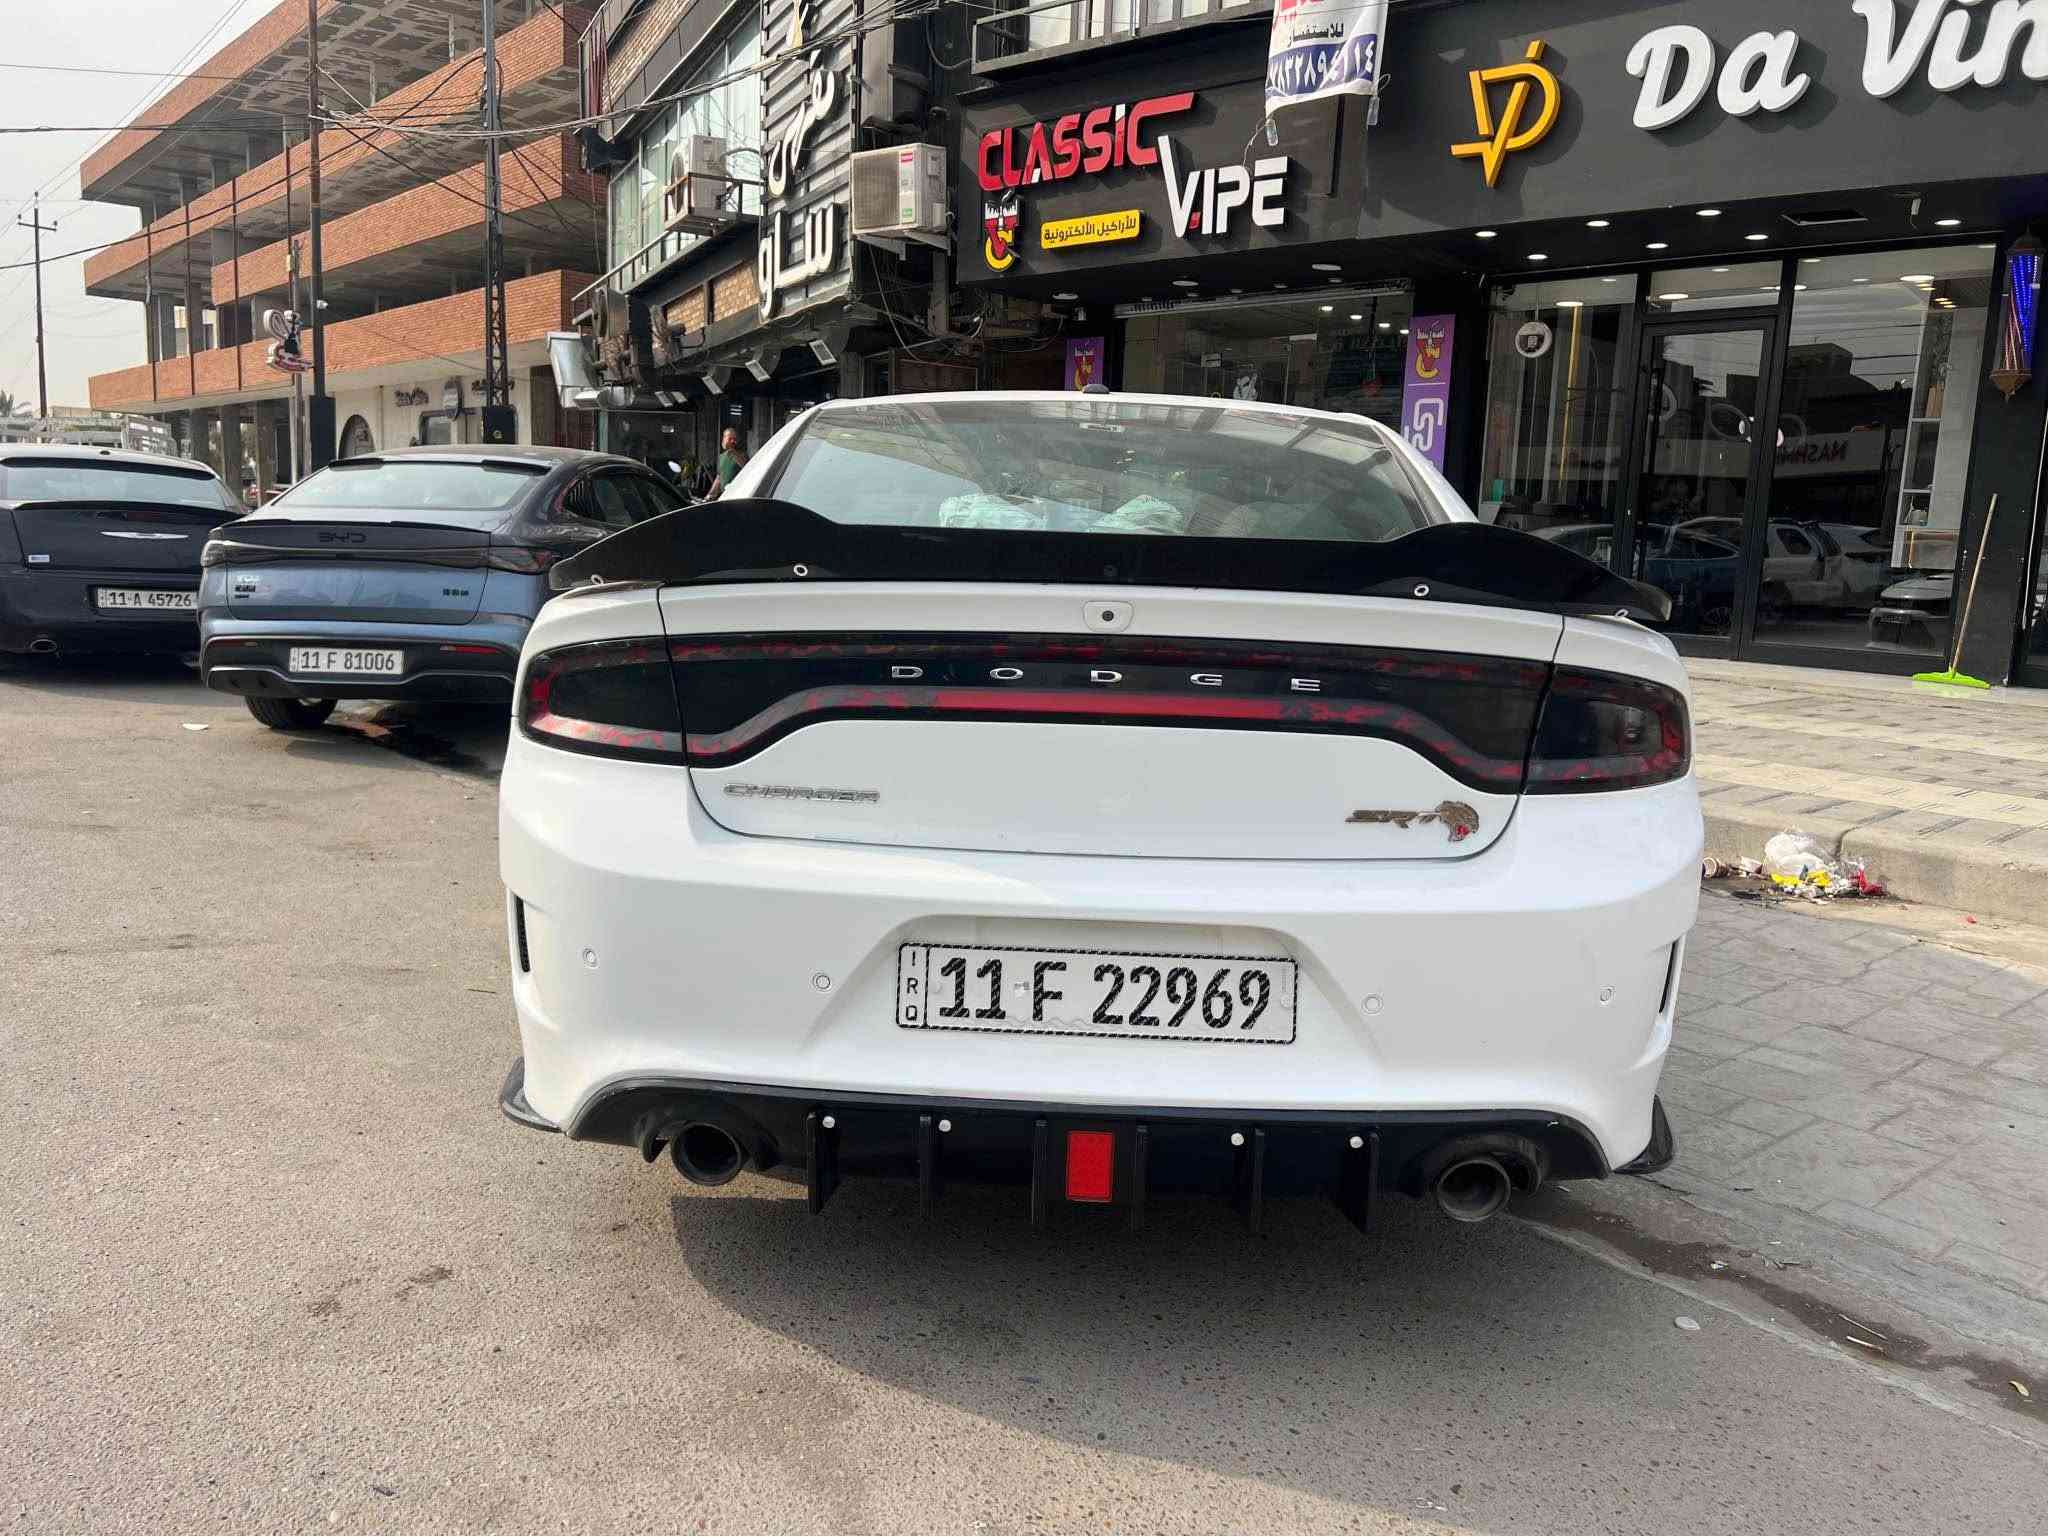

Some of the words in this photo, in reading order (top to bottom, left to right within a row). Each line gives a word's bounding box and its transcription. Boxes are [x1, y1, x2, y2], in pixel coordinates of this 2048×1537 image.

[1626, 24, 1809, 131] Da
[978, 91, 1195, 191] CLASSIC
[318, 531, 367, 543] BYD
[109, 591, 128, 607] 11
[133, 592, 143, 607] A
[148, 592, 193, 608] 45726
[301, 651, 321, 669] 11
[327, 652, 338, 669] F
[343, 652, 395, 671] 81006
[891, 665, 1320, 692] DODGE
[905, 951, 919, 1021] IRQ
[939, 957, 1006, 1020] 11
[1032, 961, 1067, 1022] F
[1091, 963, 1272, 1031] 22969
